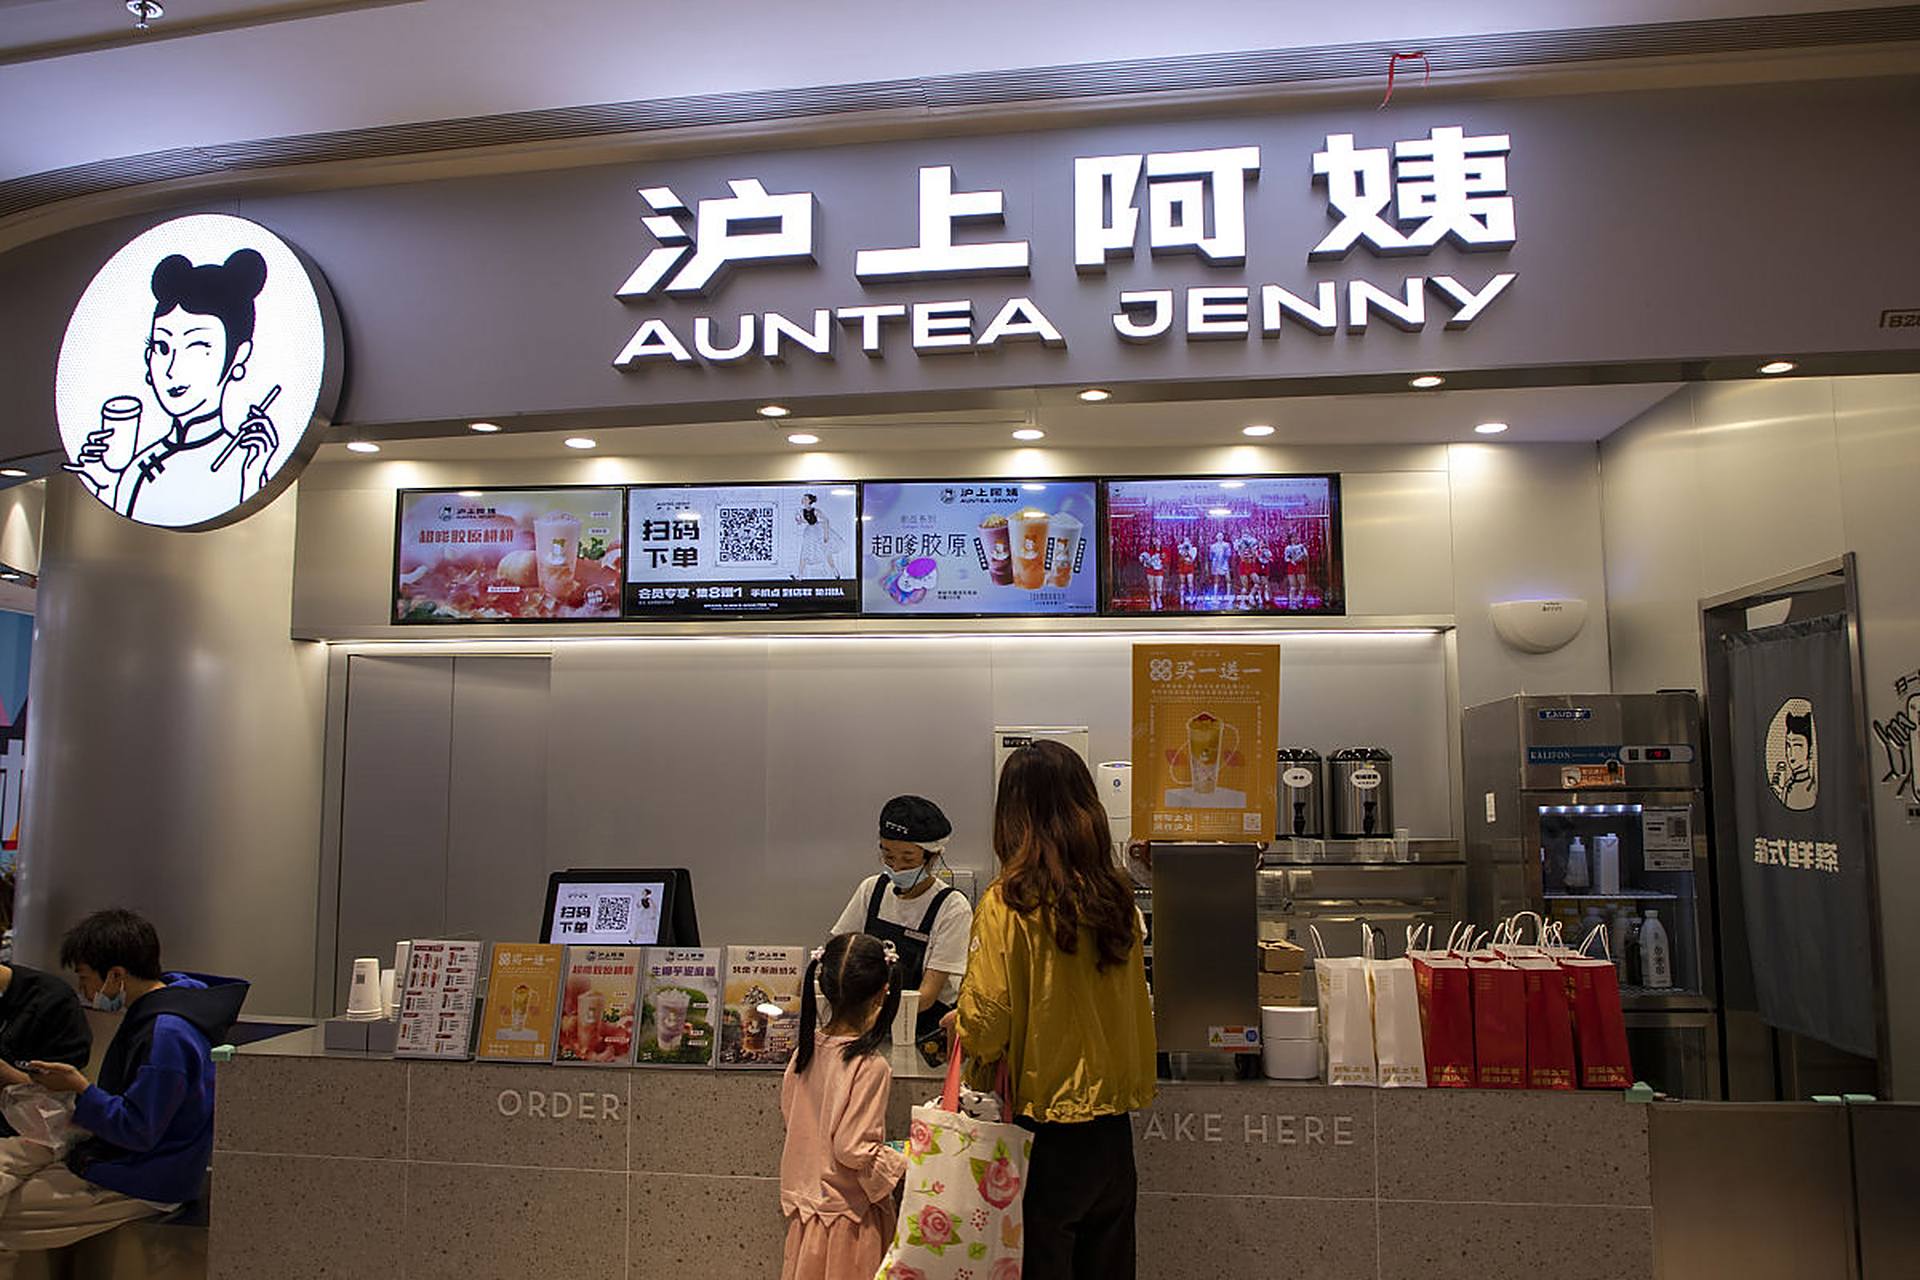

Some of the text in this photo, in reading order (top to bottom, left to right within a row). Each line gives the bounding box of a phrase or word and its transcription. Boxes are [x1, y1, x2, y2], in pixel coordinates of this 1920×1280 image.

[615, 126, 1518, 301] 沪上阿姨
[614, 272, 1517, 373] AUNTEA JENNY
[642, 518, 700, 541] 扫码
[642, 547, 699, 568] 下单
[1174, 660, 1263, 681] 买一送一
[560, 905, 591, 919] 扫码
[559, 921, 588, 934] 下单
[497, 1089, 621, 1121] ORDER
[1243, 1114, 1354, 1145] HERE
